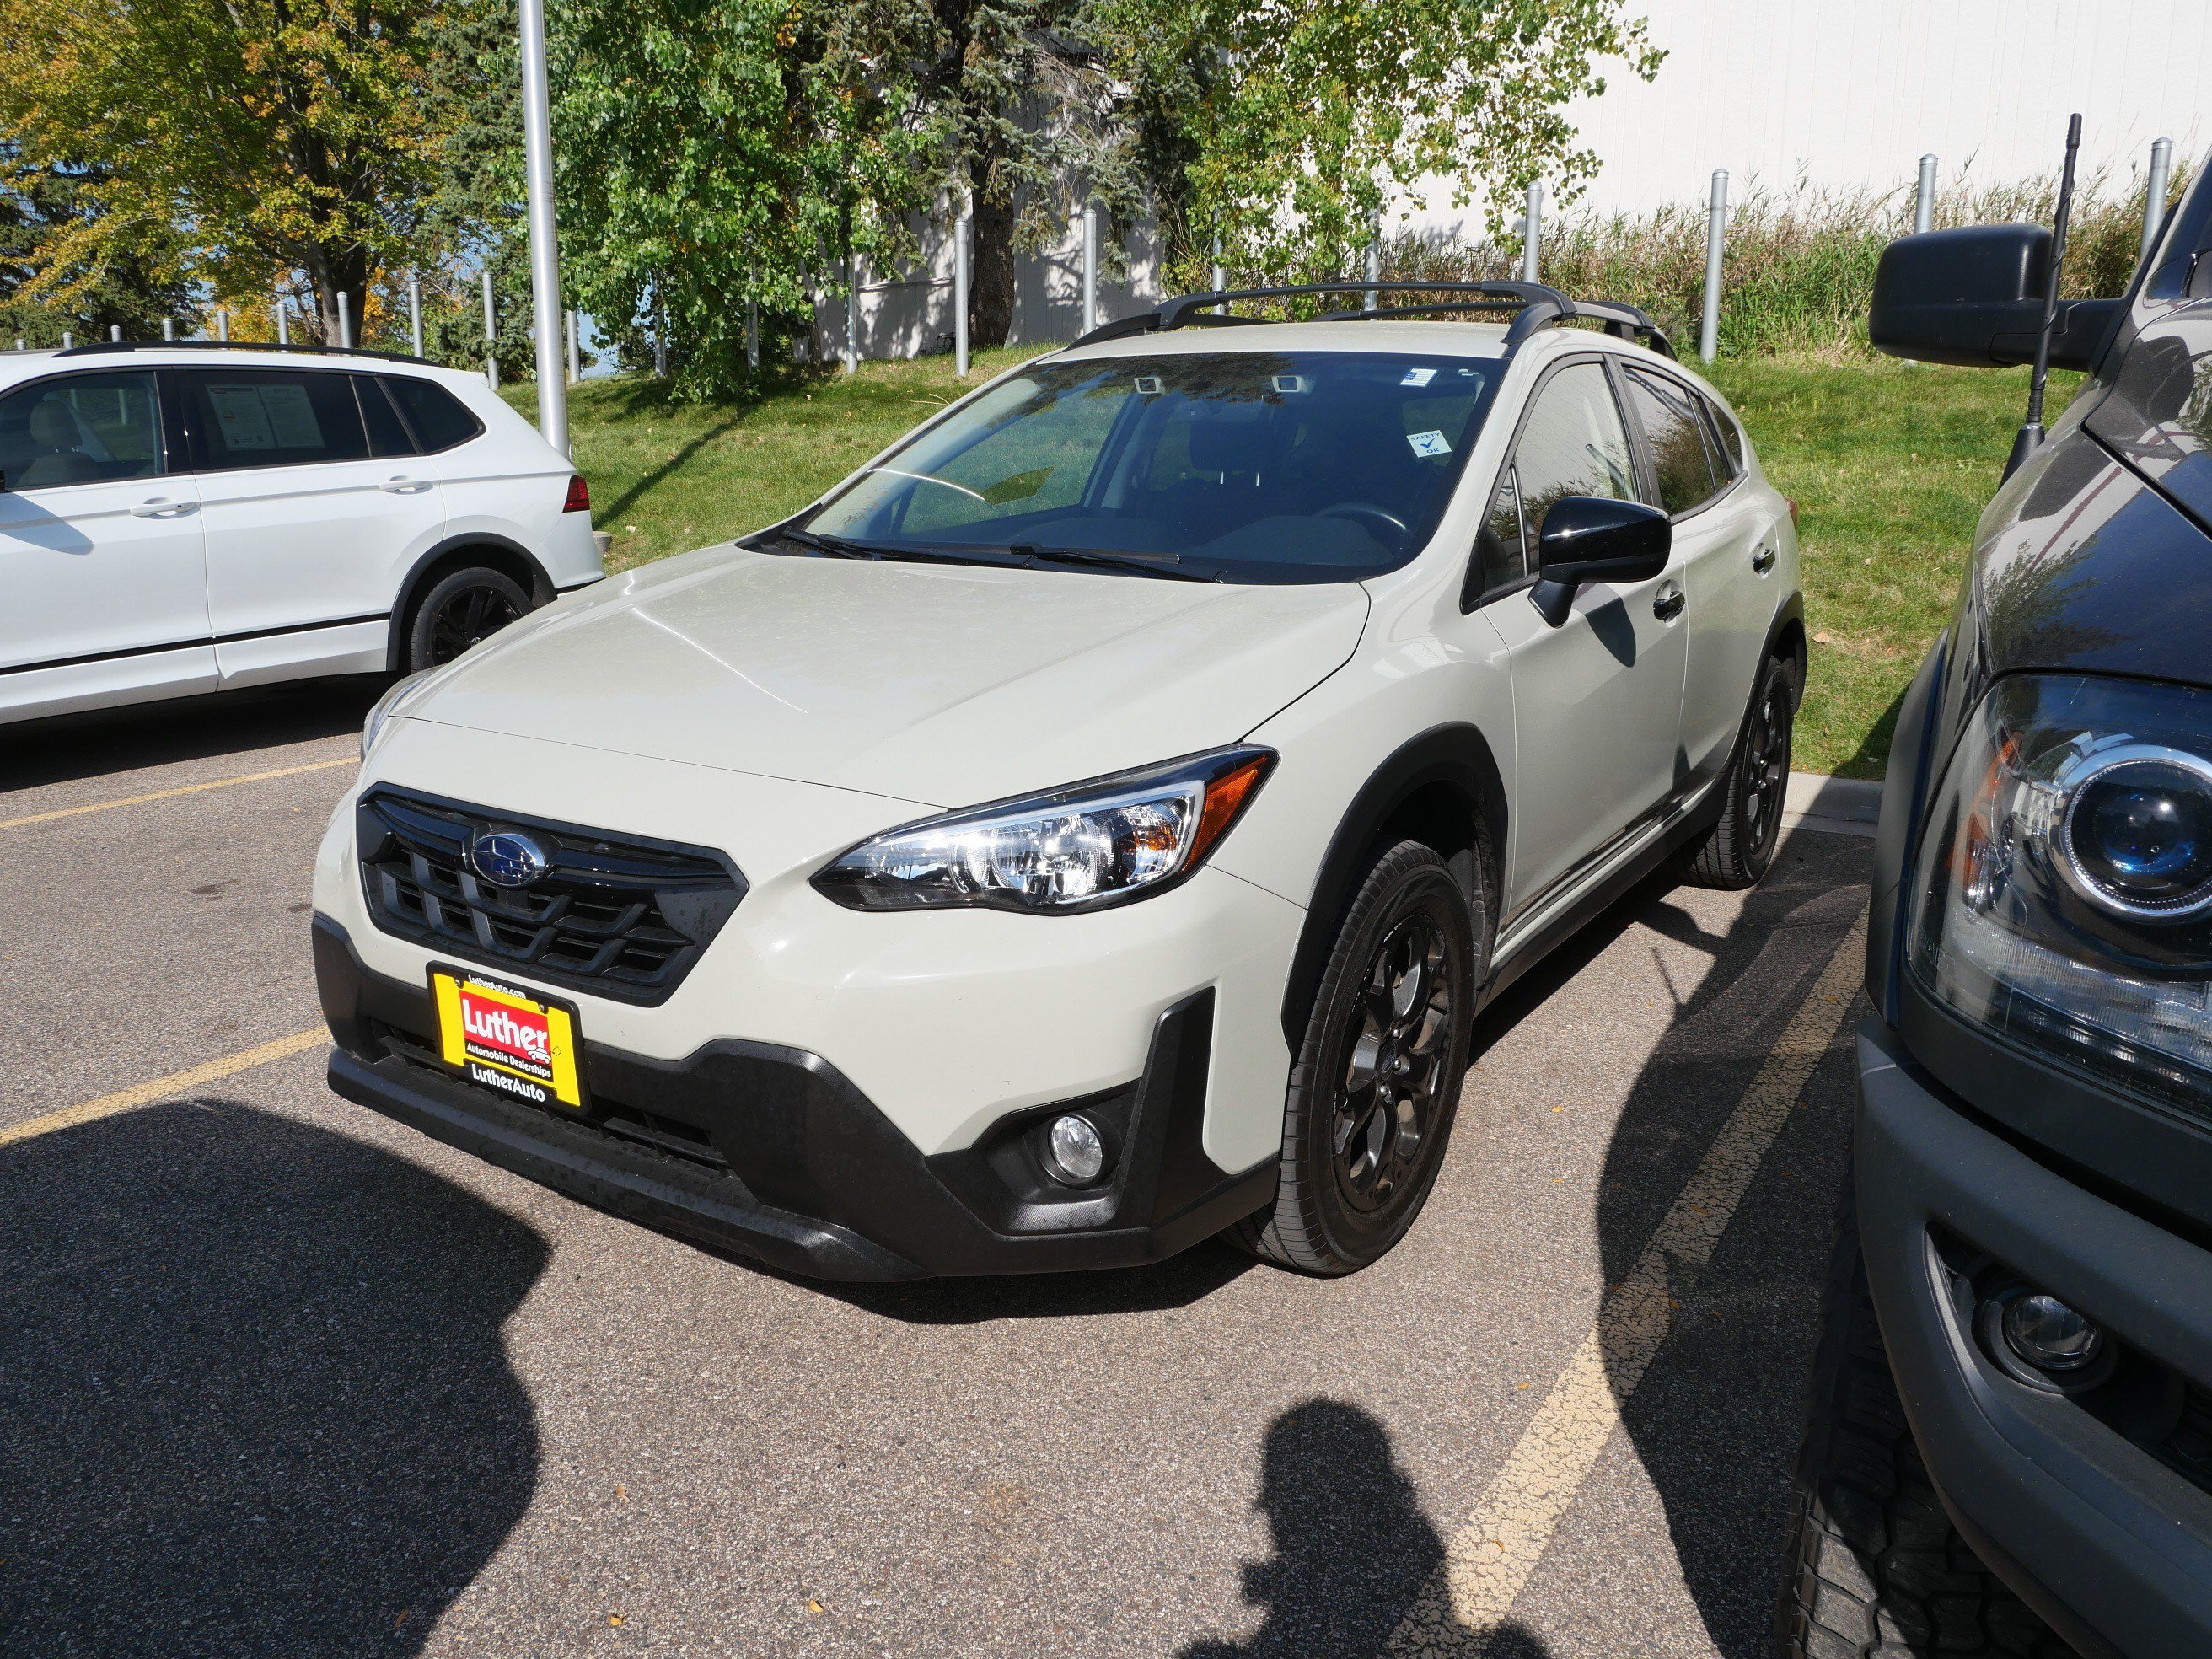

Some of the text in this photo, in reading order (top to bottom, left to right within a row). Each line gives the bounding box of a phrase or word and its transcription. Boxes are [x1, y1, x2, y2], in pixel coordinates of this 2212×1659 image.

[1410, 432, 1440, 441] SAFETY
[468, 974, 526, 1000] LutherAuto.com
[462, 998, 548, 1050] Luther
[466, 1042, 552, 1078] Automobile Dealerships
[471, 1063, 545, 1103] LutherAuto
